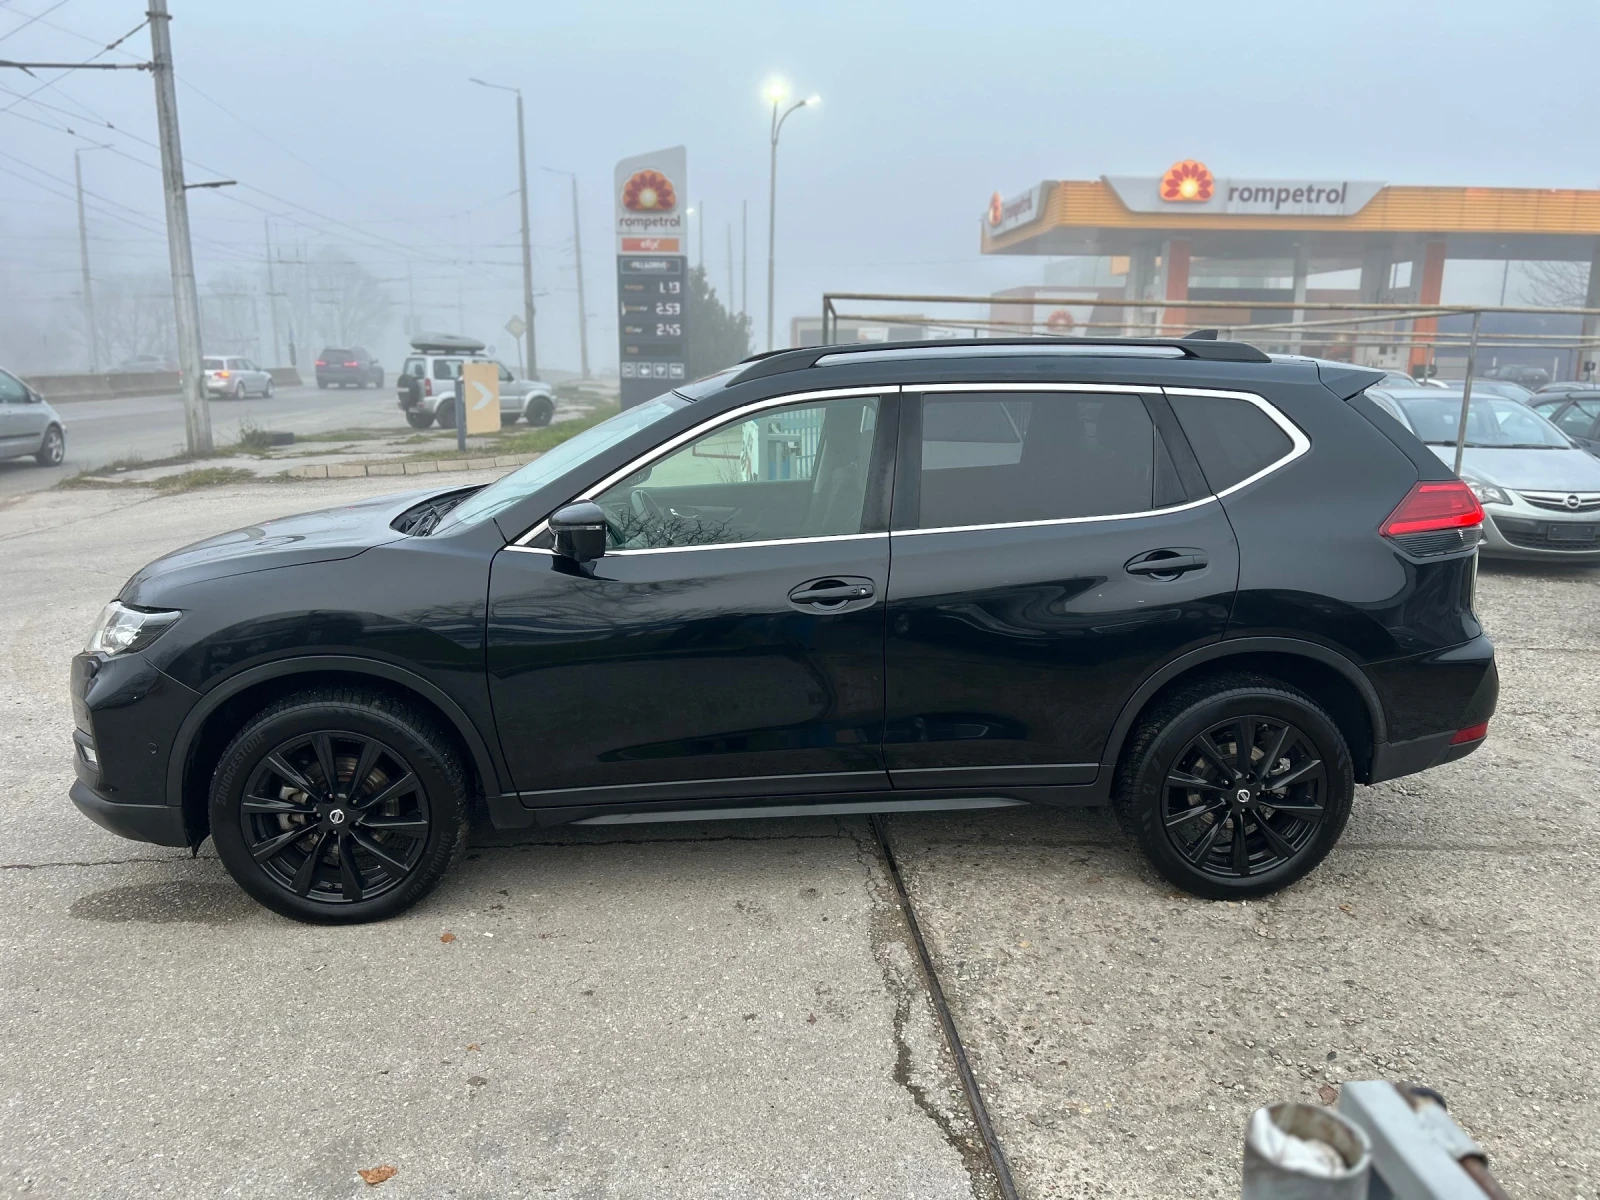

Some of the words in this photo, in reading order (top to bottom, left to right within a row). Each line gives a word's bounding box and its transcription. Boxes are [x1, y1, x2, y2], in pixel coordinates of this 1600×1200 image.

[1228, 182, 1348, 210] rompetrol
[619, 215, 681, 230] rompetrol
[215, 731, 266, 807] BRIDGESTONE
